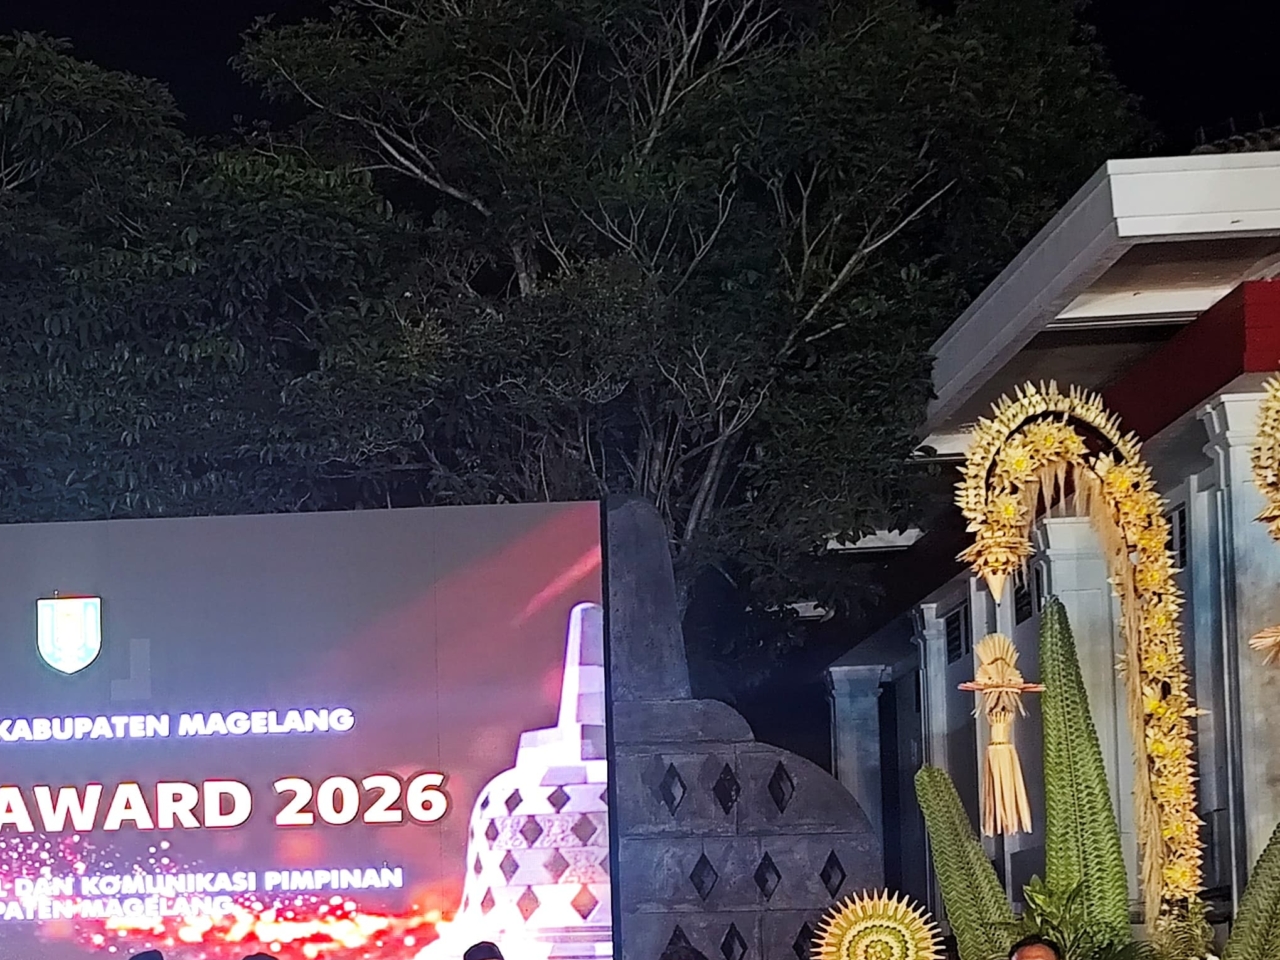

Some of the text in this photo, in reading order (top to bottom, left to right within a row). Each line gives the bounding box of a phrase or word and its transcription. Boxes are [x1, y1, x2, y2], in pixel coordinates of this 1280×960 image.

[177, 707, 356, 736] MAGELANG
[272, 773, 449, 828] 2026
[14, 876, 74, 898] DAN
[81, 871, 257, 896] KOMUNIKASI
[264, 866, 404, 891] PIMPINAN
[79, 896, 236, 919] MAGELANG
